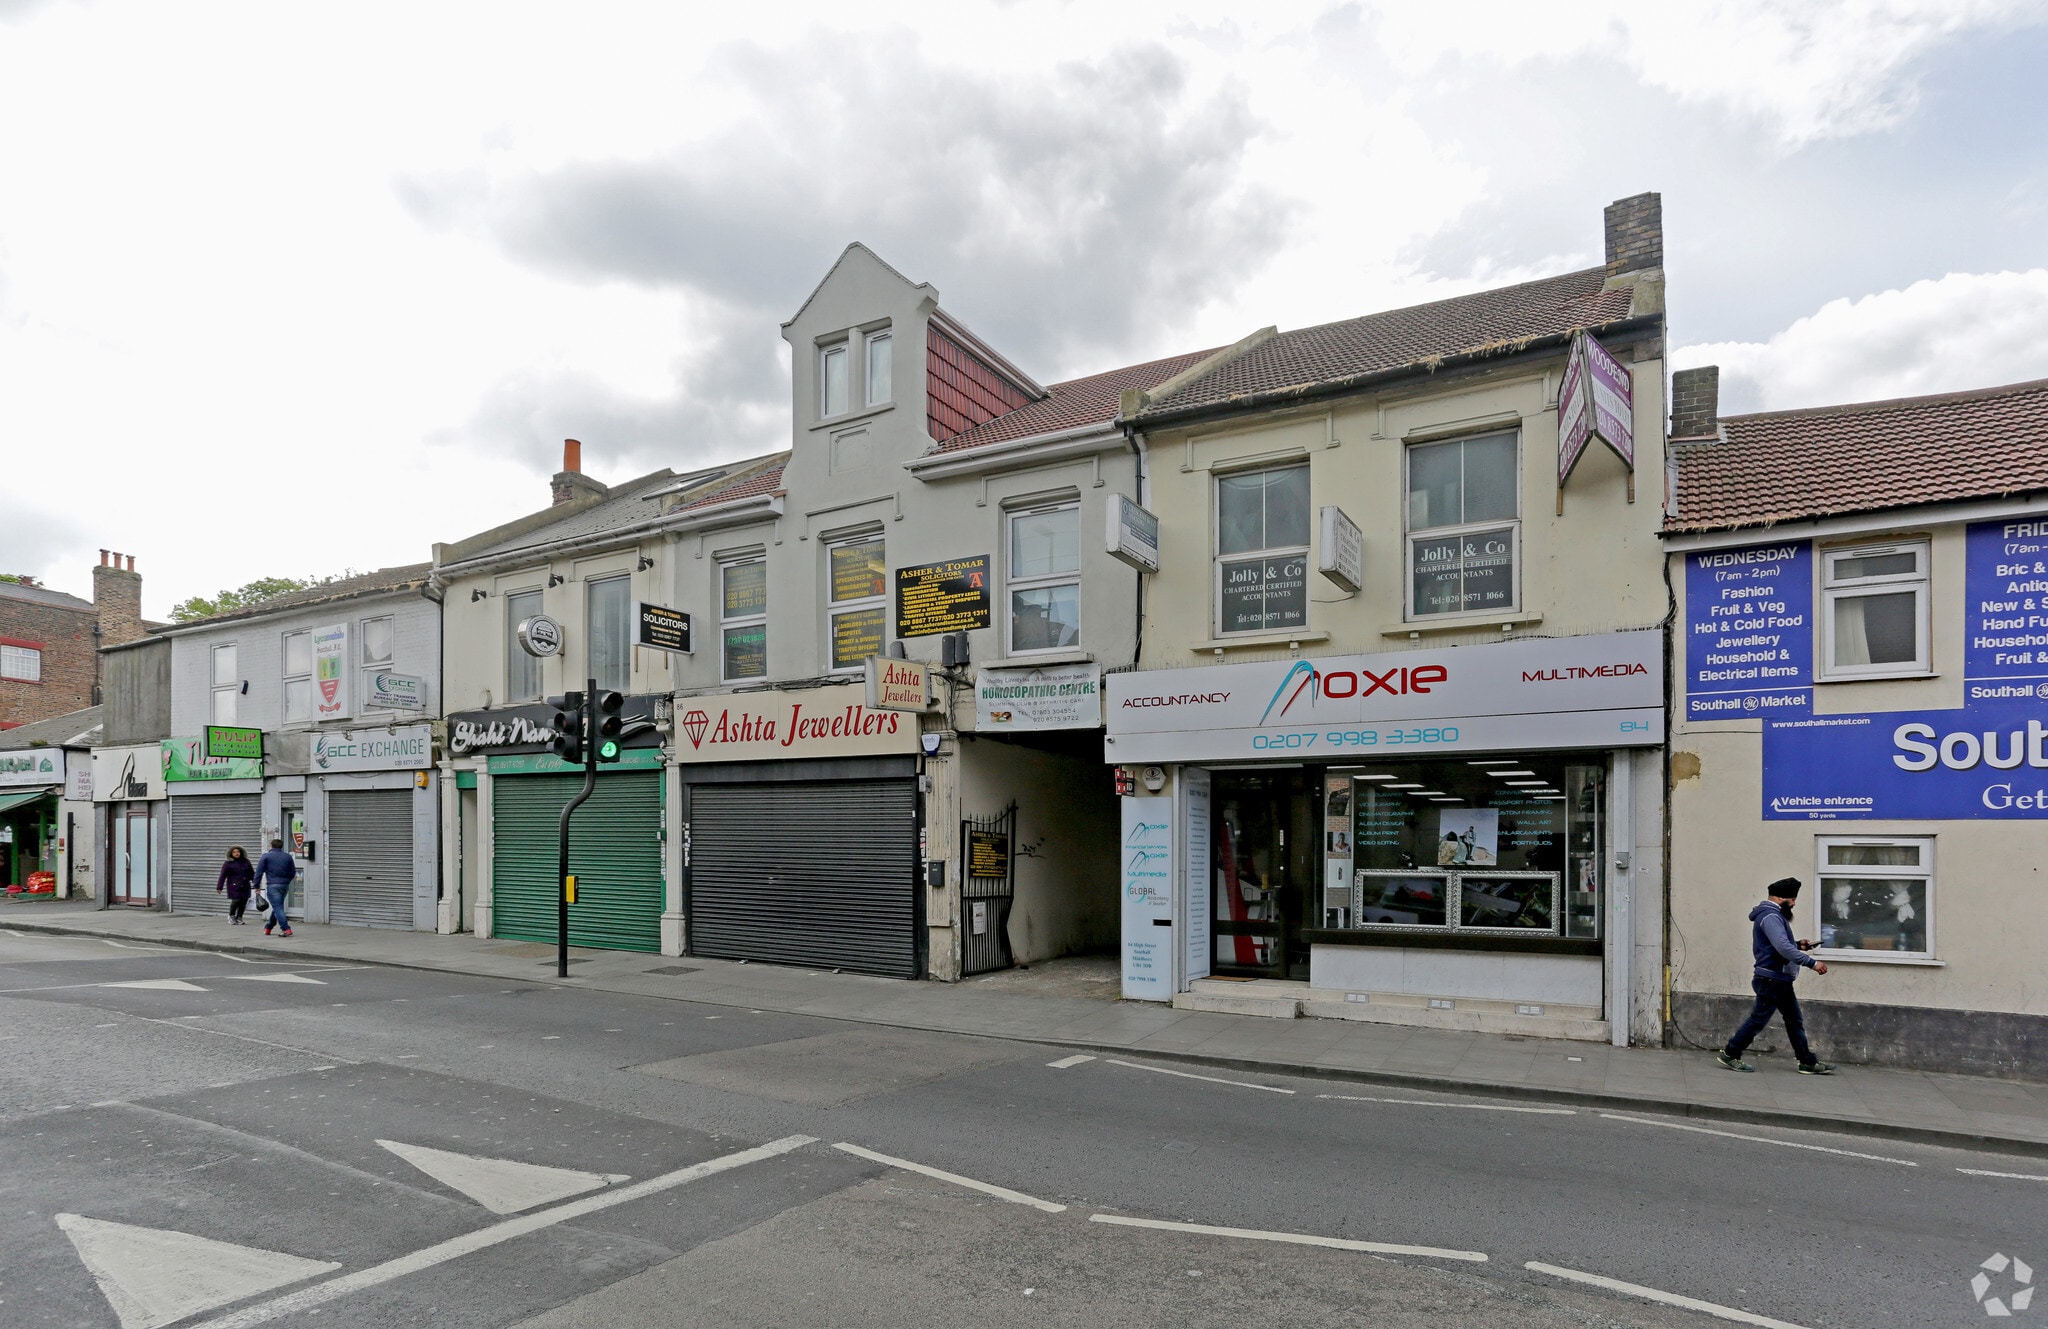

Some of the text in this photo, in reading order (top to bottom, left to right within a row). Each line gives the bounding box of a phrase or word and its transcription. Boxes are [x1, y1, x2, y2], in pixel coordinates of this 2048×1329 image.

[1587, 339, 1629, 392] WOODEND
[1421, 540, 1505, 562] Jolly & Co
[1698, 546, 1798, 568] WEDNESDAY
[901, 568, 933, 579] ASHER
[945, 560, 984, 571] TOMAR
[1229, 563, 1302, 584] Jolly & Co
[1415, 558, 1507, 574] CHARTERED CERTIFIED
[1715, 565, 1781, 582] (7am 2pm)
[1996, 562, 2046, 576] Bric &
[921, 570, 962, 581] SOLICITORS
[1436, 570, 1494, 581] ACCOUNTANTS
[1224, 580, 1302, 594] CHARTERED CERTIFIED
[1722, 586, 1774, 600] Fashion
[1241, 590, 1291, 601] ACCOUNTANTS
[1464, 593, 1481, 602] 8571
[1486, 591, 1504, 600] 1066
[1711, 601, 1786, 617] Fruit & Veg
[1981, 600, 2018, 613] New
[2023, 598, 2036, 610] &
[643, 613, 688, 631] SOLICITORS
[956, 611, 971, 619] 3773
[1265, 612, 1280, 620] 8571
[1284, 610, 1300, 619] 1066
[1695, 615, 1803, 634] Hot & Cold Food
[1982, 617, 2025, 630] Hand
[1716, 635, 1780, 649] Jewellery
[1706, 648, 1790, 665] Household &
[1995, 652, 2032, 665] Fruit
[882, 663, 920, 687] Ashta
[1699, 665, 1799, 681] Electrical Items
[388, 679, 416, 688] GCC
[982, 681, 1095, 699] HOMOEOPATHIC CENTRE
[1122, 692, 1231, 708] ACCOUNTANCY
[1522, 663, 1648, 682] MULTIMEDIA
[882, 686, 921, 704] Jewellers
[1971, 685, 2034, 699] Southall
[1691, 694, 1806, 711] Southall Market
[710, 704, 899, 747] Ashta Jewellers
[1620, 720, 1648, 732] 84
[1772, 718, 1871, 728] www.southallmarket.com
[214, 731, 257, 742] TULIP
[1253, 727, 1459, 750] 0207 998 3380
[328, 739, 424, 758] GCC EXCHANGE
[1781, 796, 1873, 806] Vehicle entrance
[1129, 887, 1157, 895] GLOBAL
